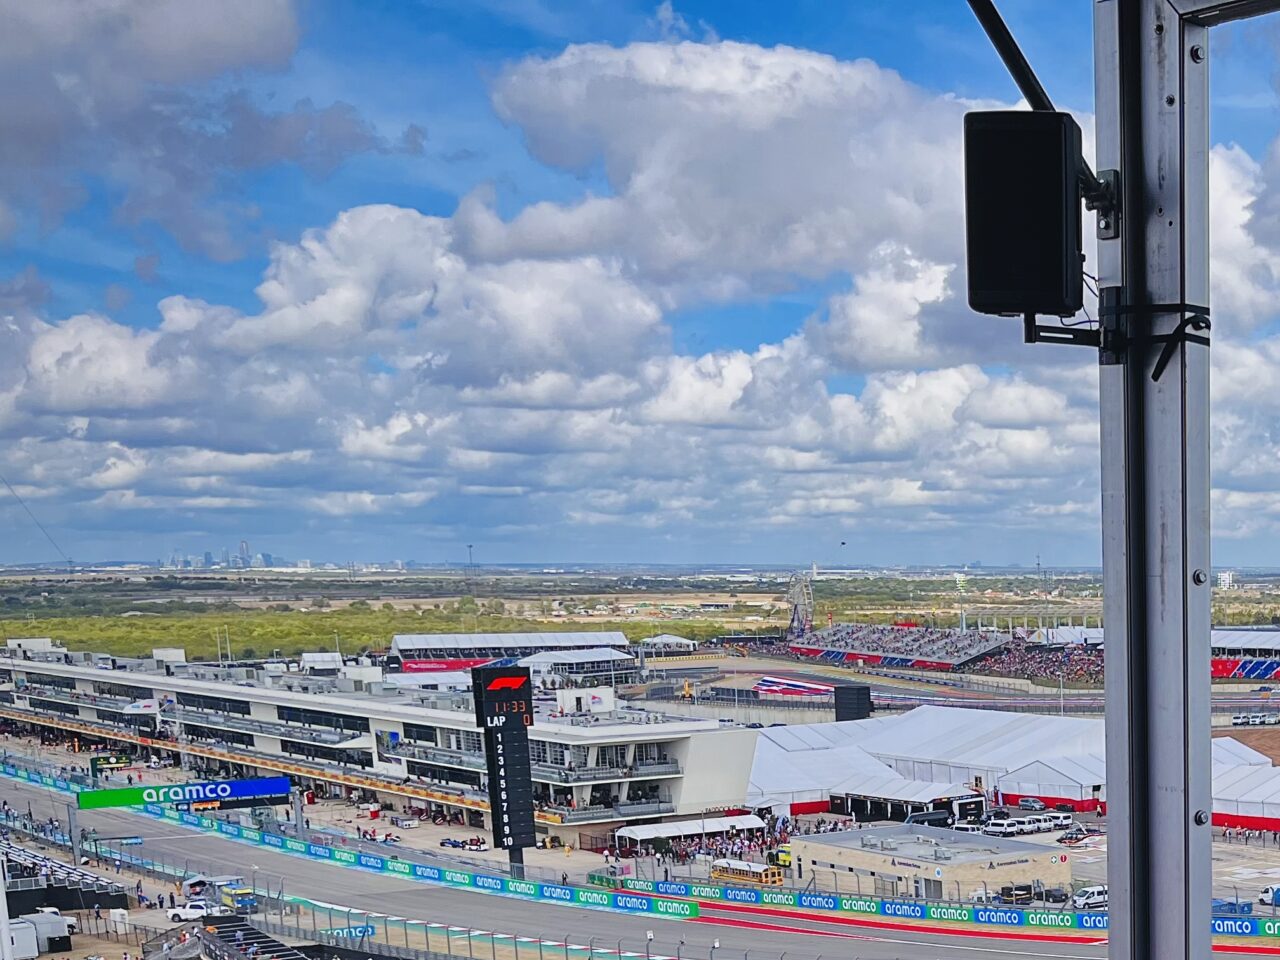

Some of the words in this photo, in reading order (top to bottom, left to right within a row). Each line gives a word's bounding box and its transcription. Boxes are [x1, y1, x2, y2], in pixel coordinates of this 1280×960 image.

[495, 700, 526, 712] 11:33
[486, 716, 506, 727] LAP
[523, 714, 530, 726] 0
[496, 733, 502, 742] 1
[497, 744, 503, 753] 2
[498, 756, 504, 765] 3
[499, 768, 505, 776] 4
[500, 780, 506, 788] 5
[143, 784, 230, 802] aramco
[501, 791, 507, 800] 6
[502, 802, 508, 811] 7
[503, 814, 509, 823] 8
[504, 826, 510, 834] 9
[502, 837, 513, 846] 10
[361, 856, 381, 868] aramco
[388, 861, 409, 873] aramco
[416, 866, 438, 878] aramco
[446, 871, 469, 883] aramco
[476, 876, 501, 889] aramco
[509, 882, 535, 894] aramco
[627, 879, 652, 891] aramco
[659, 883, 685, 894] aramco
[543, 886, 570, 900] aramco
[580, 891, 608, 905] aramco
[692, 886, 720, 898] aramco
[727, 890, 755, 901] aramco
[618, 896, 647, 910] aramco
[763, 893, 794, 904] aramco
[802, 896, 834, 908] aramco
[658, 901, 690, 915] aramco
[842, 899, 876, 913] aramco
[885, 903, 921, 917] aramco
[930, 907, 968, 921] aramco
[978, 911, 1018, 924] aramco
[1028, 914, 1071, 927] aramco
